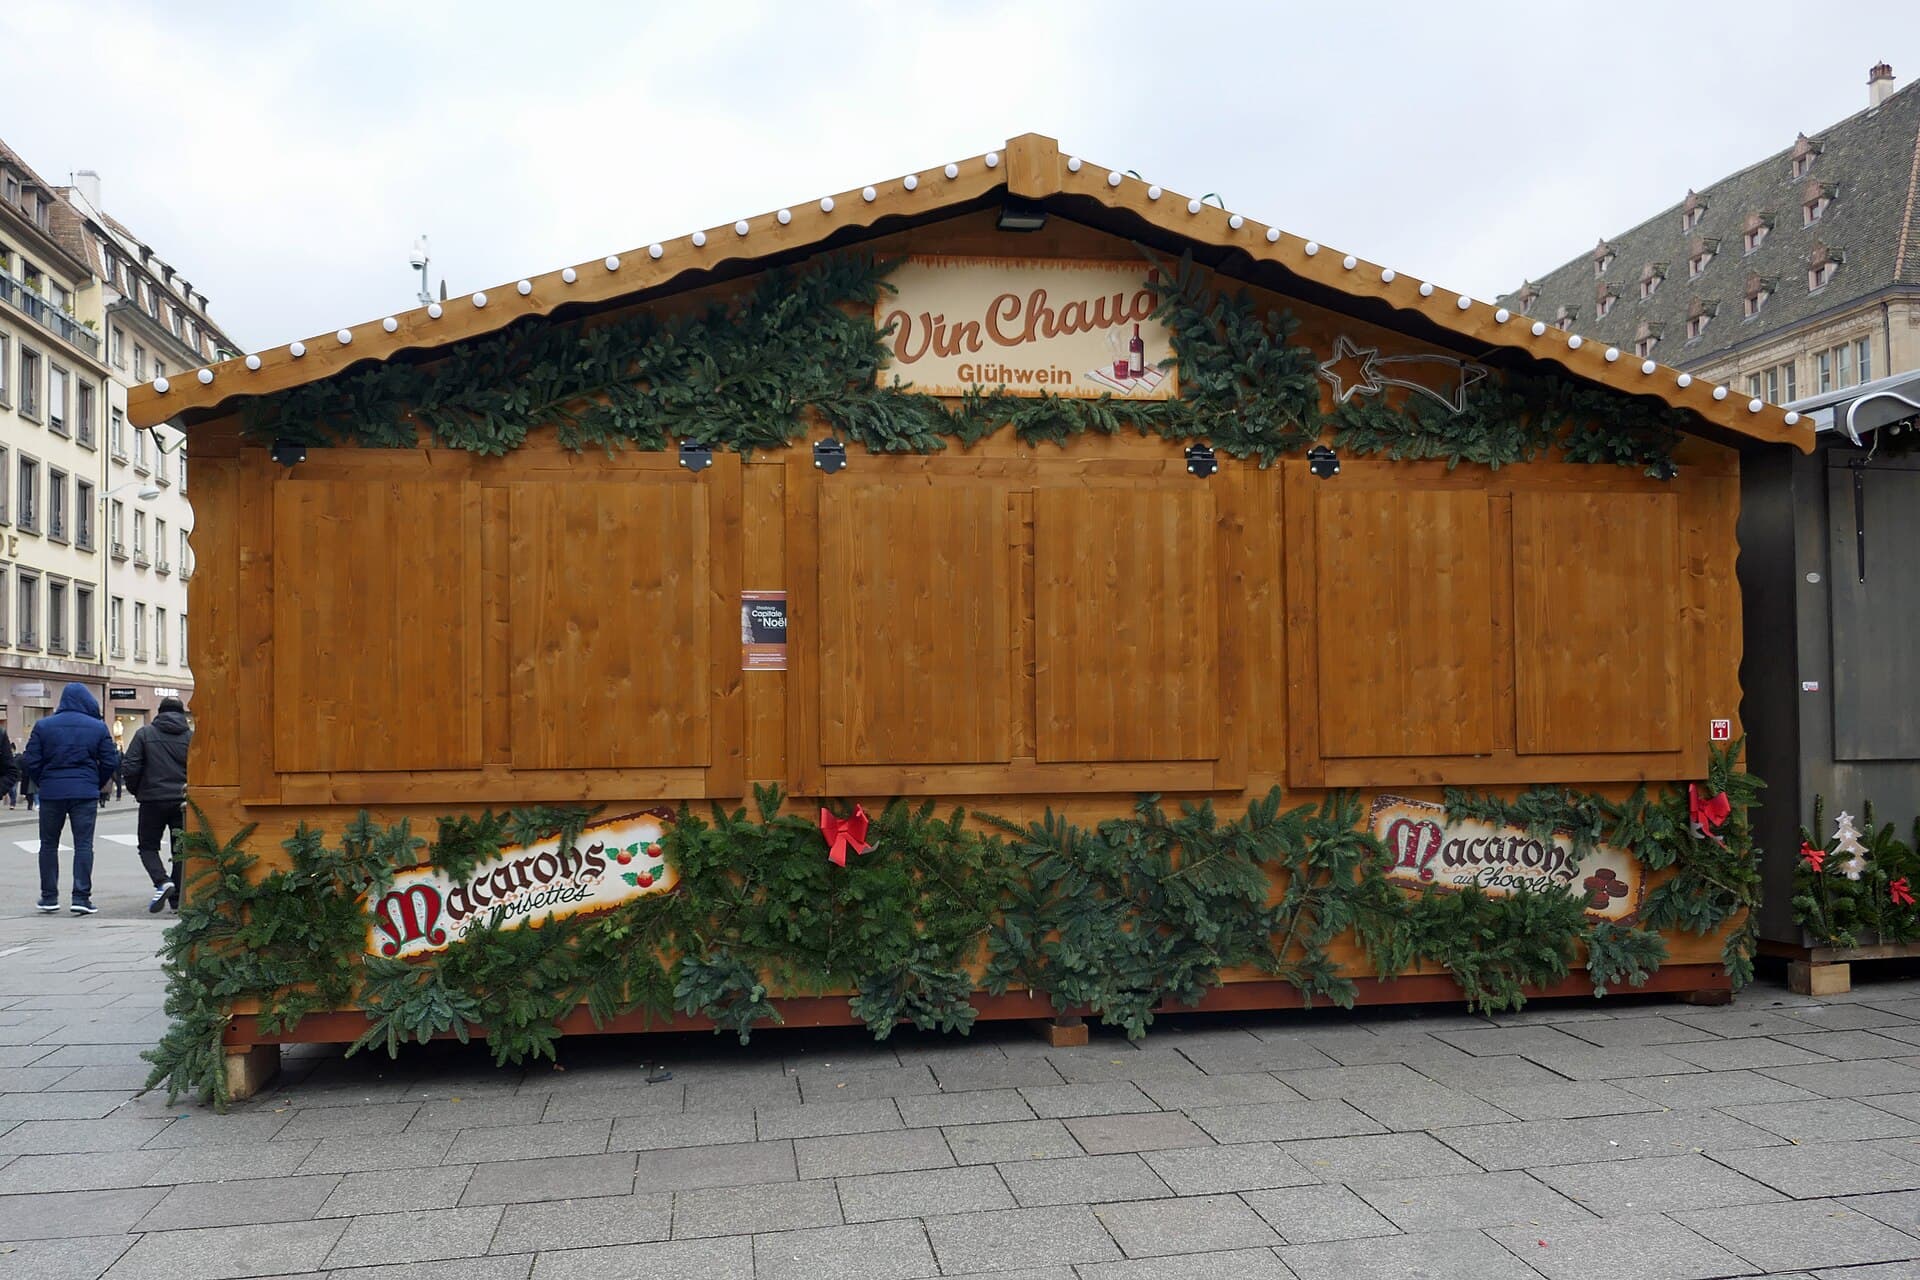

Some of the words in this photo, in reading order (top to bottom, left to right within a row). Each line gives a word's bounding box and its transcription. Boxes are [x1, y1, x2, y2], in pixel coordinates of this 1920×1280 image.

[884, 309, 983, 365] Vin
[985, 268, 1160, 347] Chaud
[957, 363, 1072, 385] Glühwein
[763, 617, 787, 627] Noël
[1384, 818, 1584, 881] Macarons
[376, 840, 607, 956] Macarons
[1453, 873, 1473, 884] au
